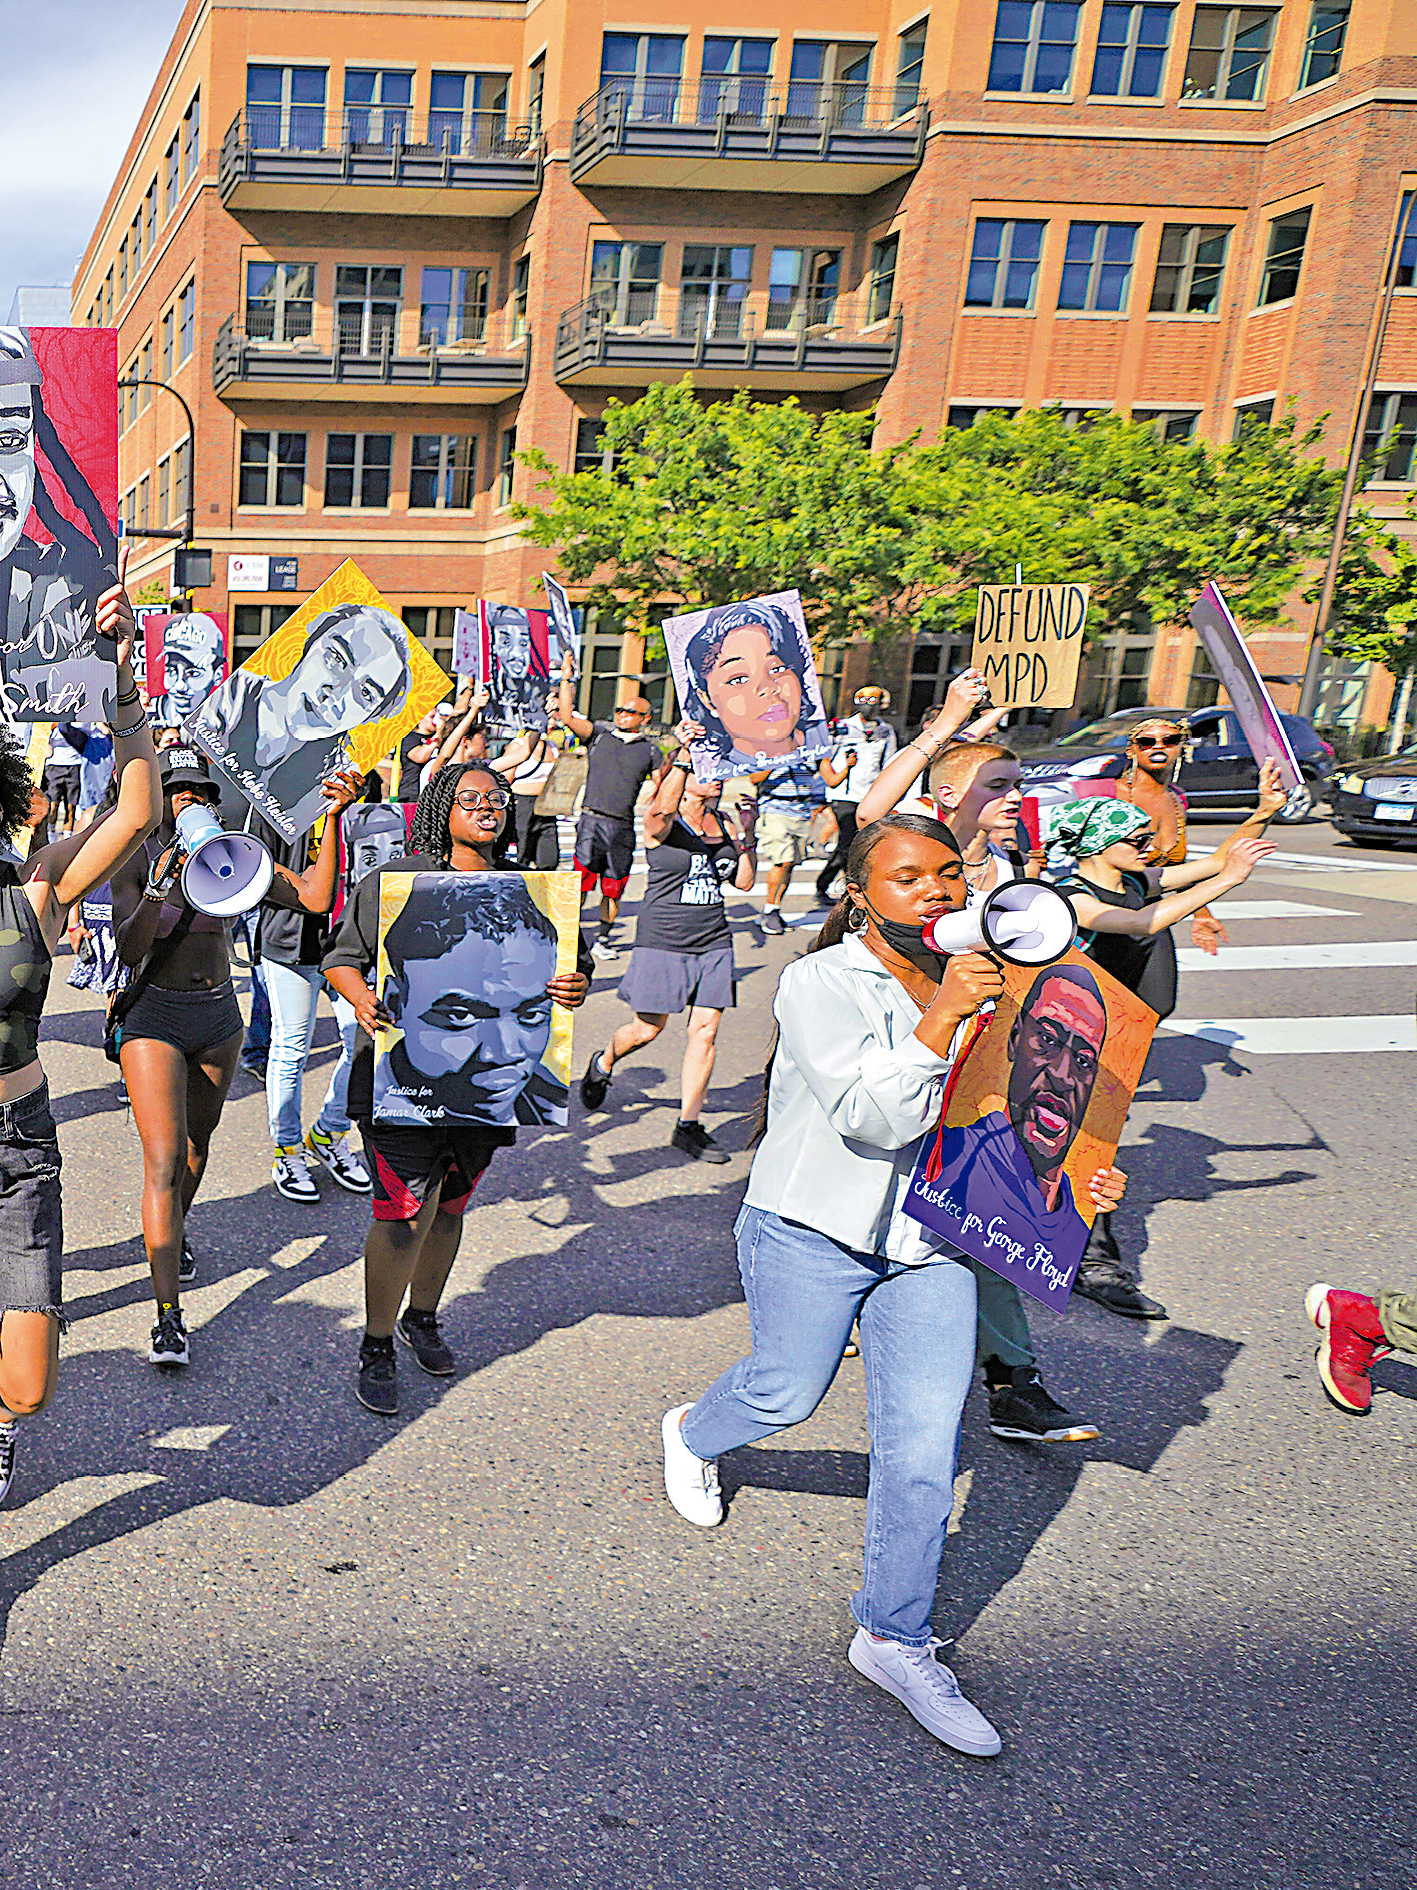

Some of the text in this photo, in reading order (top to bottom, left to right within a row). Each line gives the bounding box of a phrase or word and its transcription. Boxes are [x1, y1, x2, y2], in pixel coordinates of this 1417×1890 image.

[979, 587, 1085, 643] DEFUND
[3, 682, 90, 715] Smith
[984, 652, 1048, 703] MPD
[188, 717, 226, 756] Justice
[218, 752, 240, 772] for
[262, 794, 297, 835] Heisler
[385, 1085, 434, 1098] Justice for
[412, 1105, 445, 1118] Clark
[960, 1213, 984, 1234] for
[983, 1216, 1027, 1264] George
[1025, 1242, 1074, 1291] Floyd
